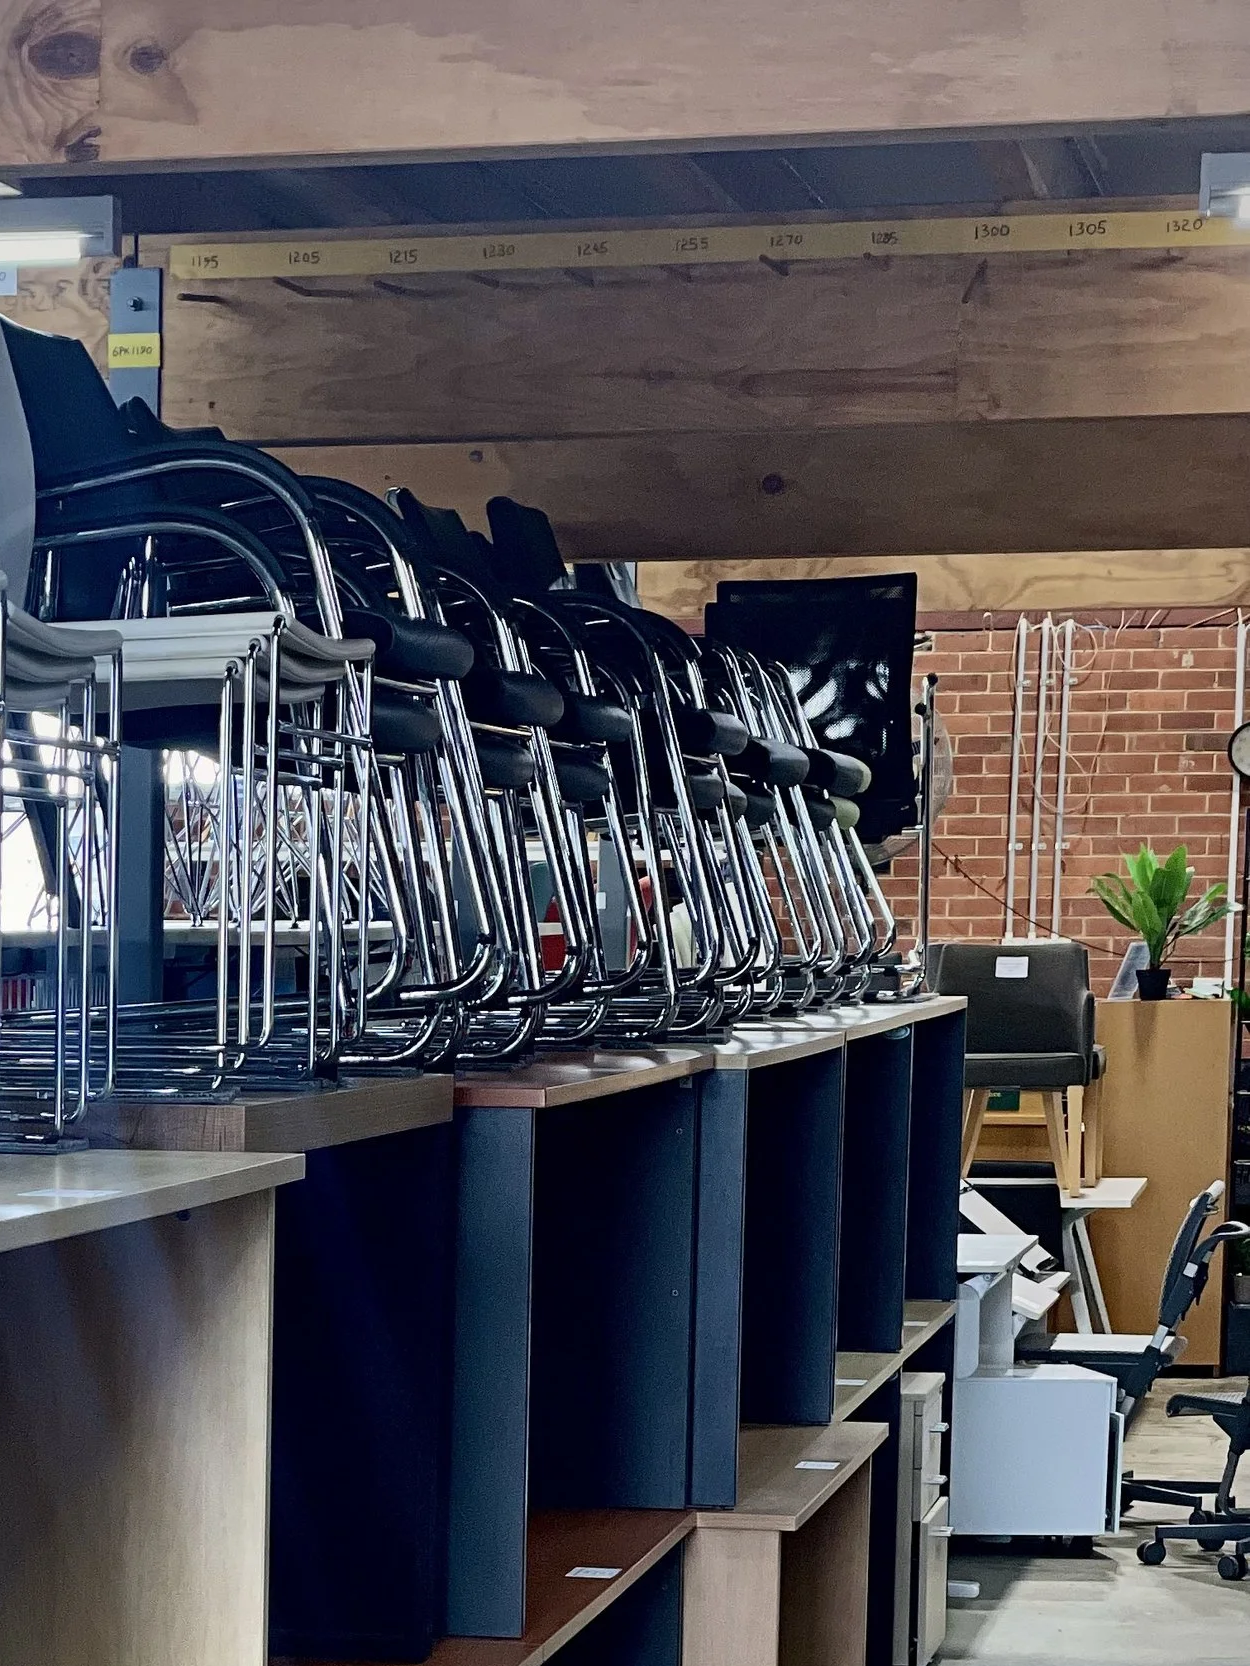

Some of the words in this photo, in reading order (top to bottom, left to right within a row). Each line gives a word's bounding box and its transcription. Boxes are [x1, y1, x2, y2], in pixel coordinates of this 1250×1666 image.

[288, 250, 321, 265] 1205
[388, 249, 419, 264] 1215
[577, 241, 609, 257] 1245
[674, 237, 710, 253] 1255
[769, 234, 803, 248] 1270
[974, 223, 1010, 240] 1300
[1069, 220, 1107, 237] 1305
[1166, 218, 1204, 233] 1320
